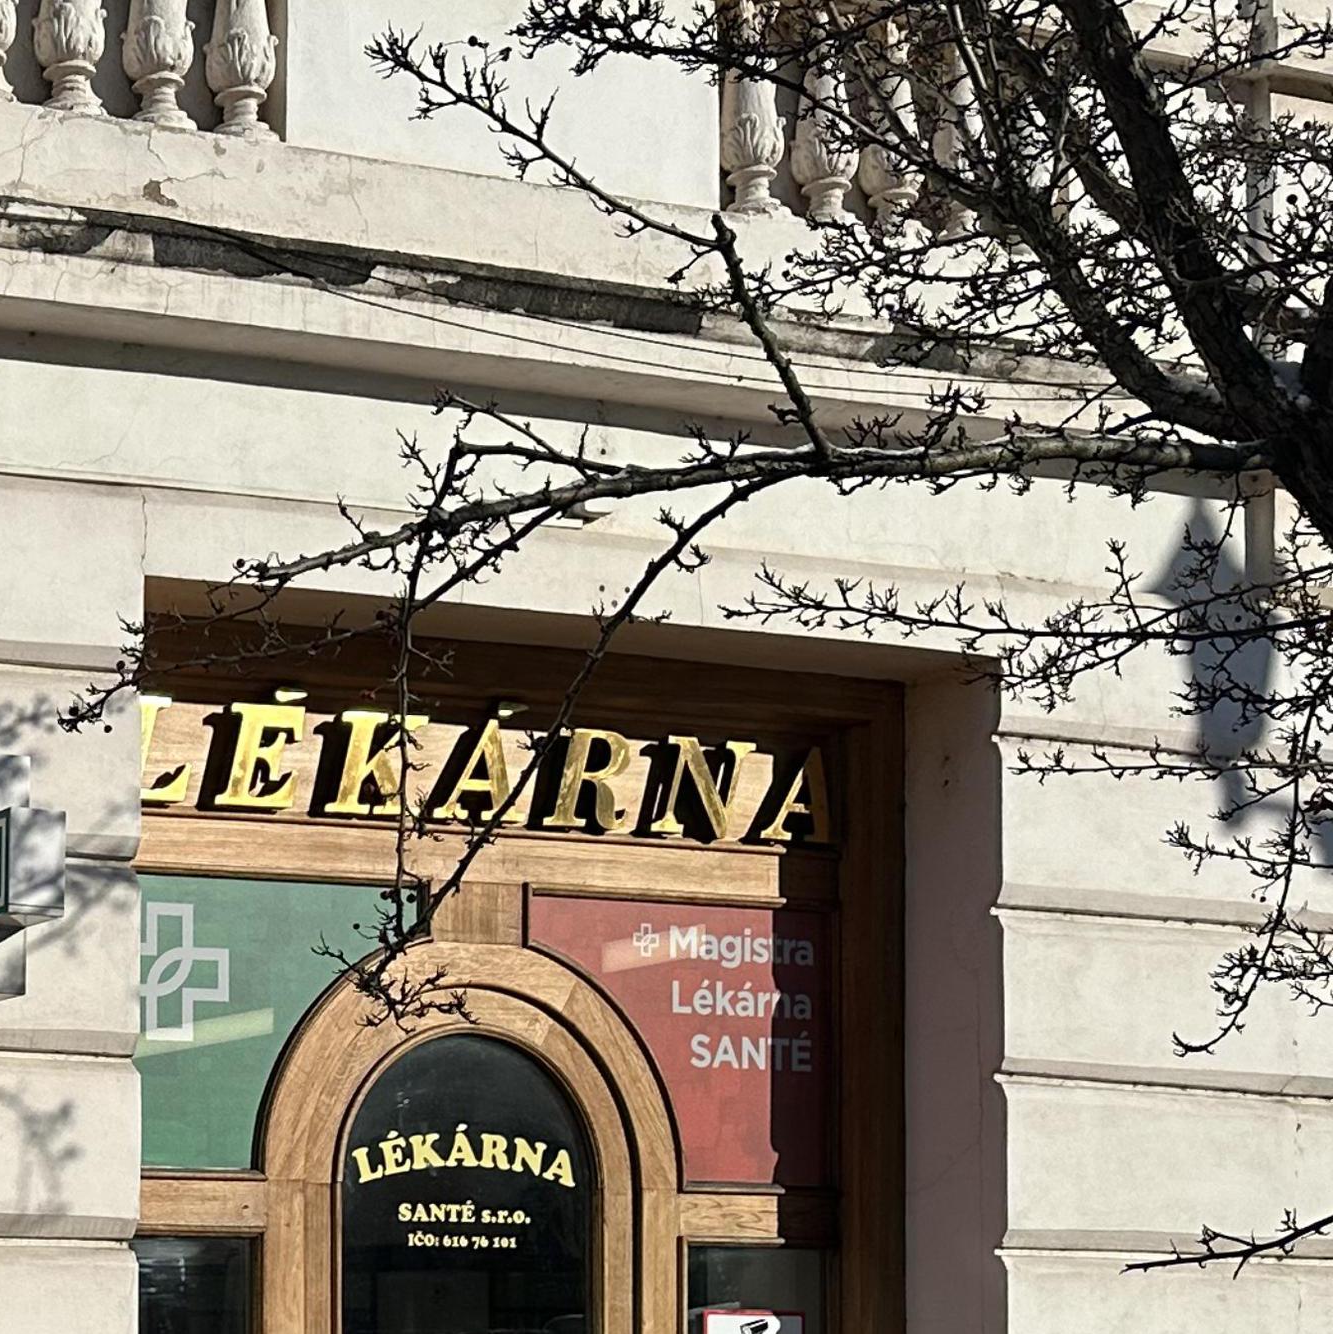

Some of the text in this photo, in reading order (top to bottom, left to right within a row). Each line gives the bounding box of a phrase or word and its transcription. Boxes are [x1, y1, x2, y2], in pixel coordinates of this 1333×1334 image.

[140, 689, 829, 843] LÉKÁRNA
[669, 925, 814, 968] Magistra
[672, 979, 813, 1020] Lékárna
[690, 1031, 813, 1073] SANTÉ
[351, 1123, 576, 1188] LÉKÁRNA
[398, 1200, 531, 1224] SANTÉ s.r.o.
[408, 1231, 440, 1247] IČO:
[492, 1237, 517, 1248] 101
